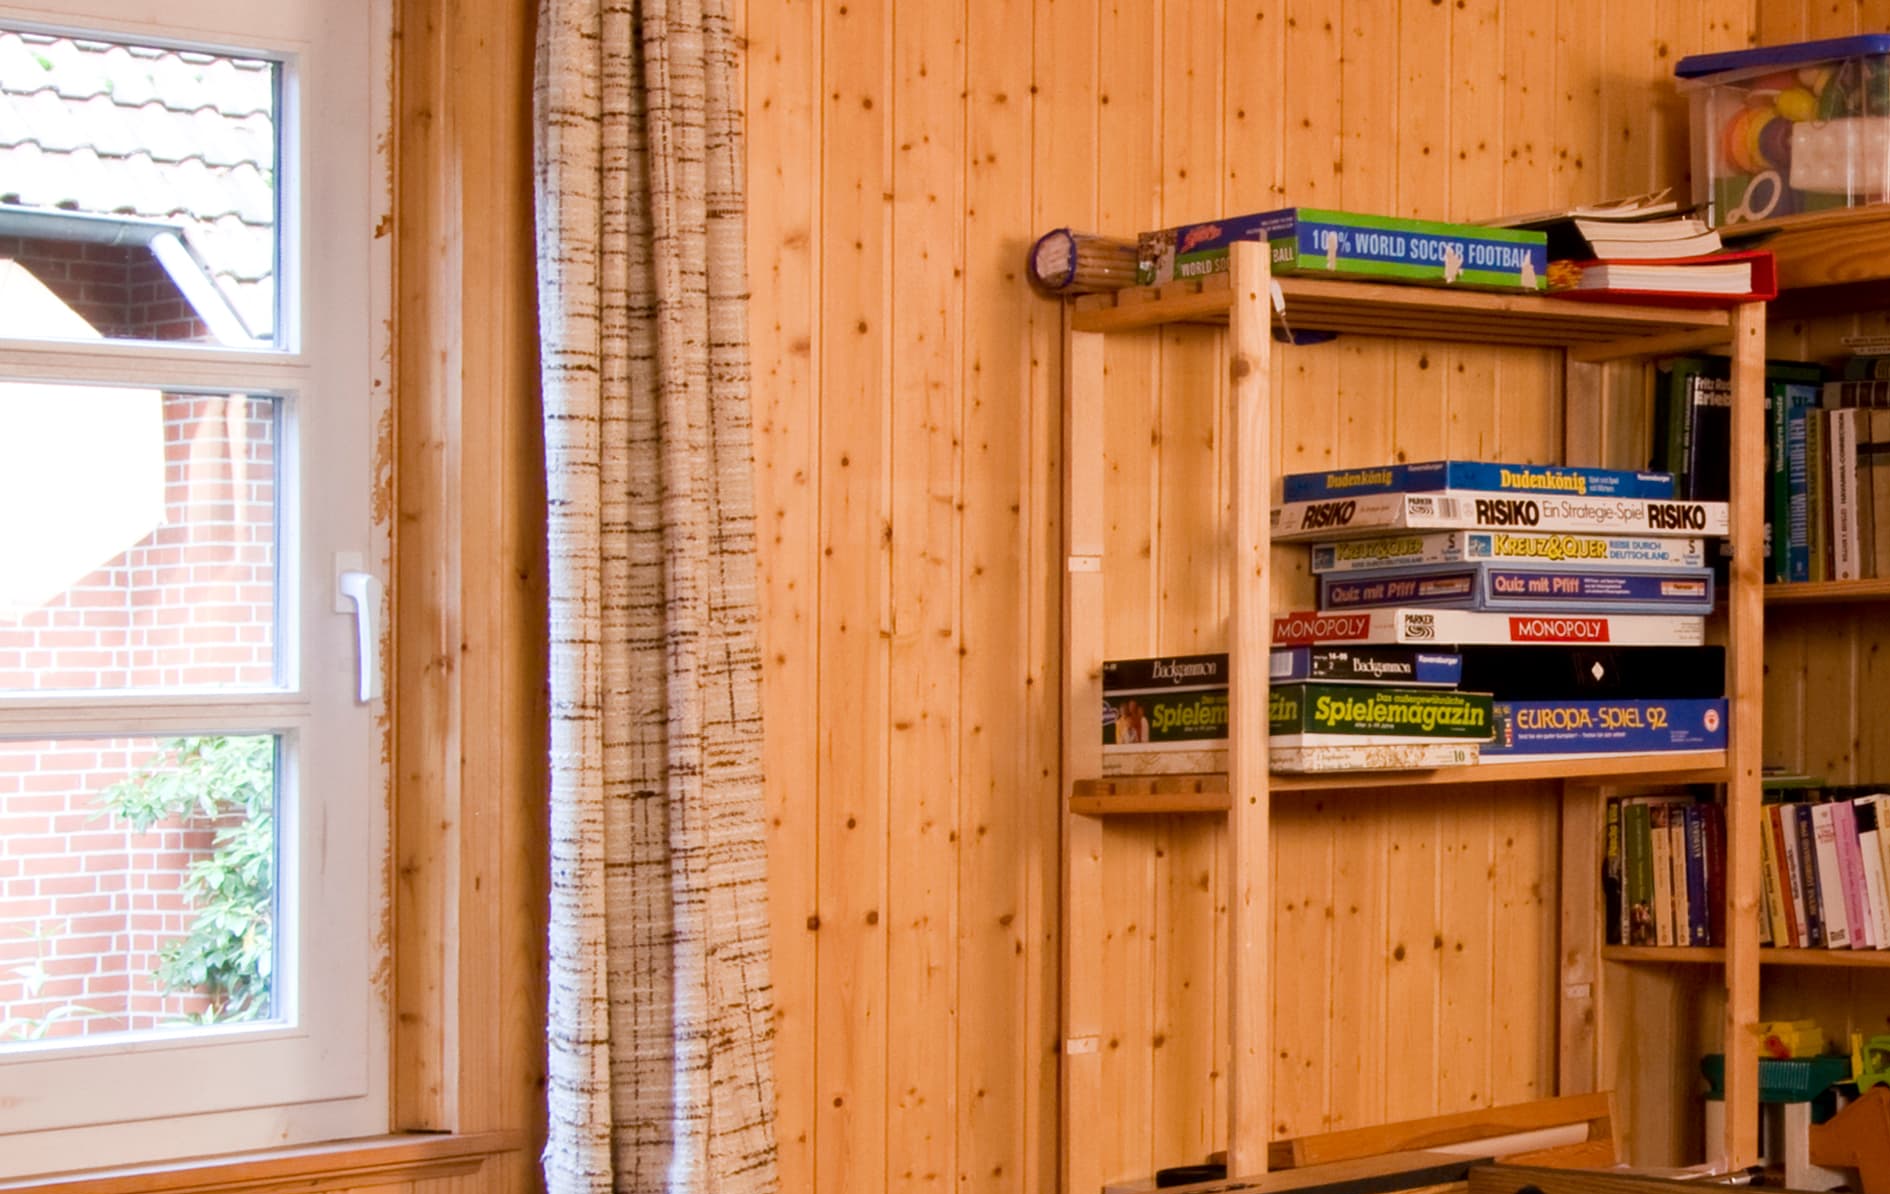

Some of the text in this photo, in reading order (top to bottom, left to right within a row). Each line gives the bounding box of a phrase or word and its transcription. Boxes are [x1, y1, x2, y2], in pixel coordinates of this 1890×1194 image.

[1312, 229, 1351, 254] 10%
[1355, 233, 1406, 258] WORLD
[1181, 260, 1212, 277] WORLD
[1500, 470, 1587, 495] Dudenkönig
[1301, 500, 1356, 529] RISIKO
[1475, 499, 1645, 526] RISIKO Ein Strategie-Spiel
[1647, 504, 1706, 530] RISIKO
[1493, 532, 1609, 561] KREUZ&QUER
[1609, 540, 1662, 551] REISE DURCH
[1609, 550, 1670, 561] DEUTSCHLAND
[1332, 581, 1416, 604] Quiz mit Pfiff
[1495, 576, 1526, 594] Quiz
[1528, 577, 1549, 593] mit
[1553, 577, 1579, 593] Pfiff
[1276, 617, 1366, 639] MONOPOLY
[1405, 614, 1434, 625] PARKER
[1518, 620, 1601, 638] MONOPOLY
[1152, 660, 1217, 684] Backgammon
[1352, 657, 1412, 678] Backgammon
[1315, 696, 1485, 732] Spielemagazin
[1517, 707, 1668, 731] EUROPA-SPIEL 92
[1453, 751, 1465, 762] 10
